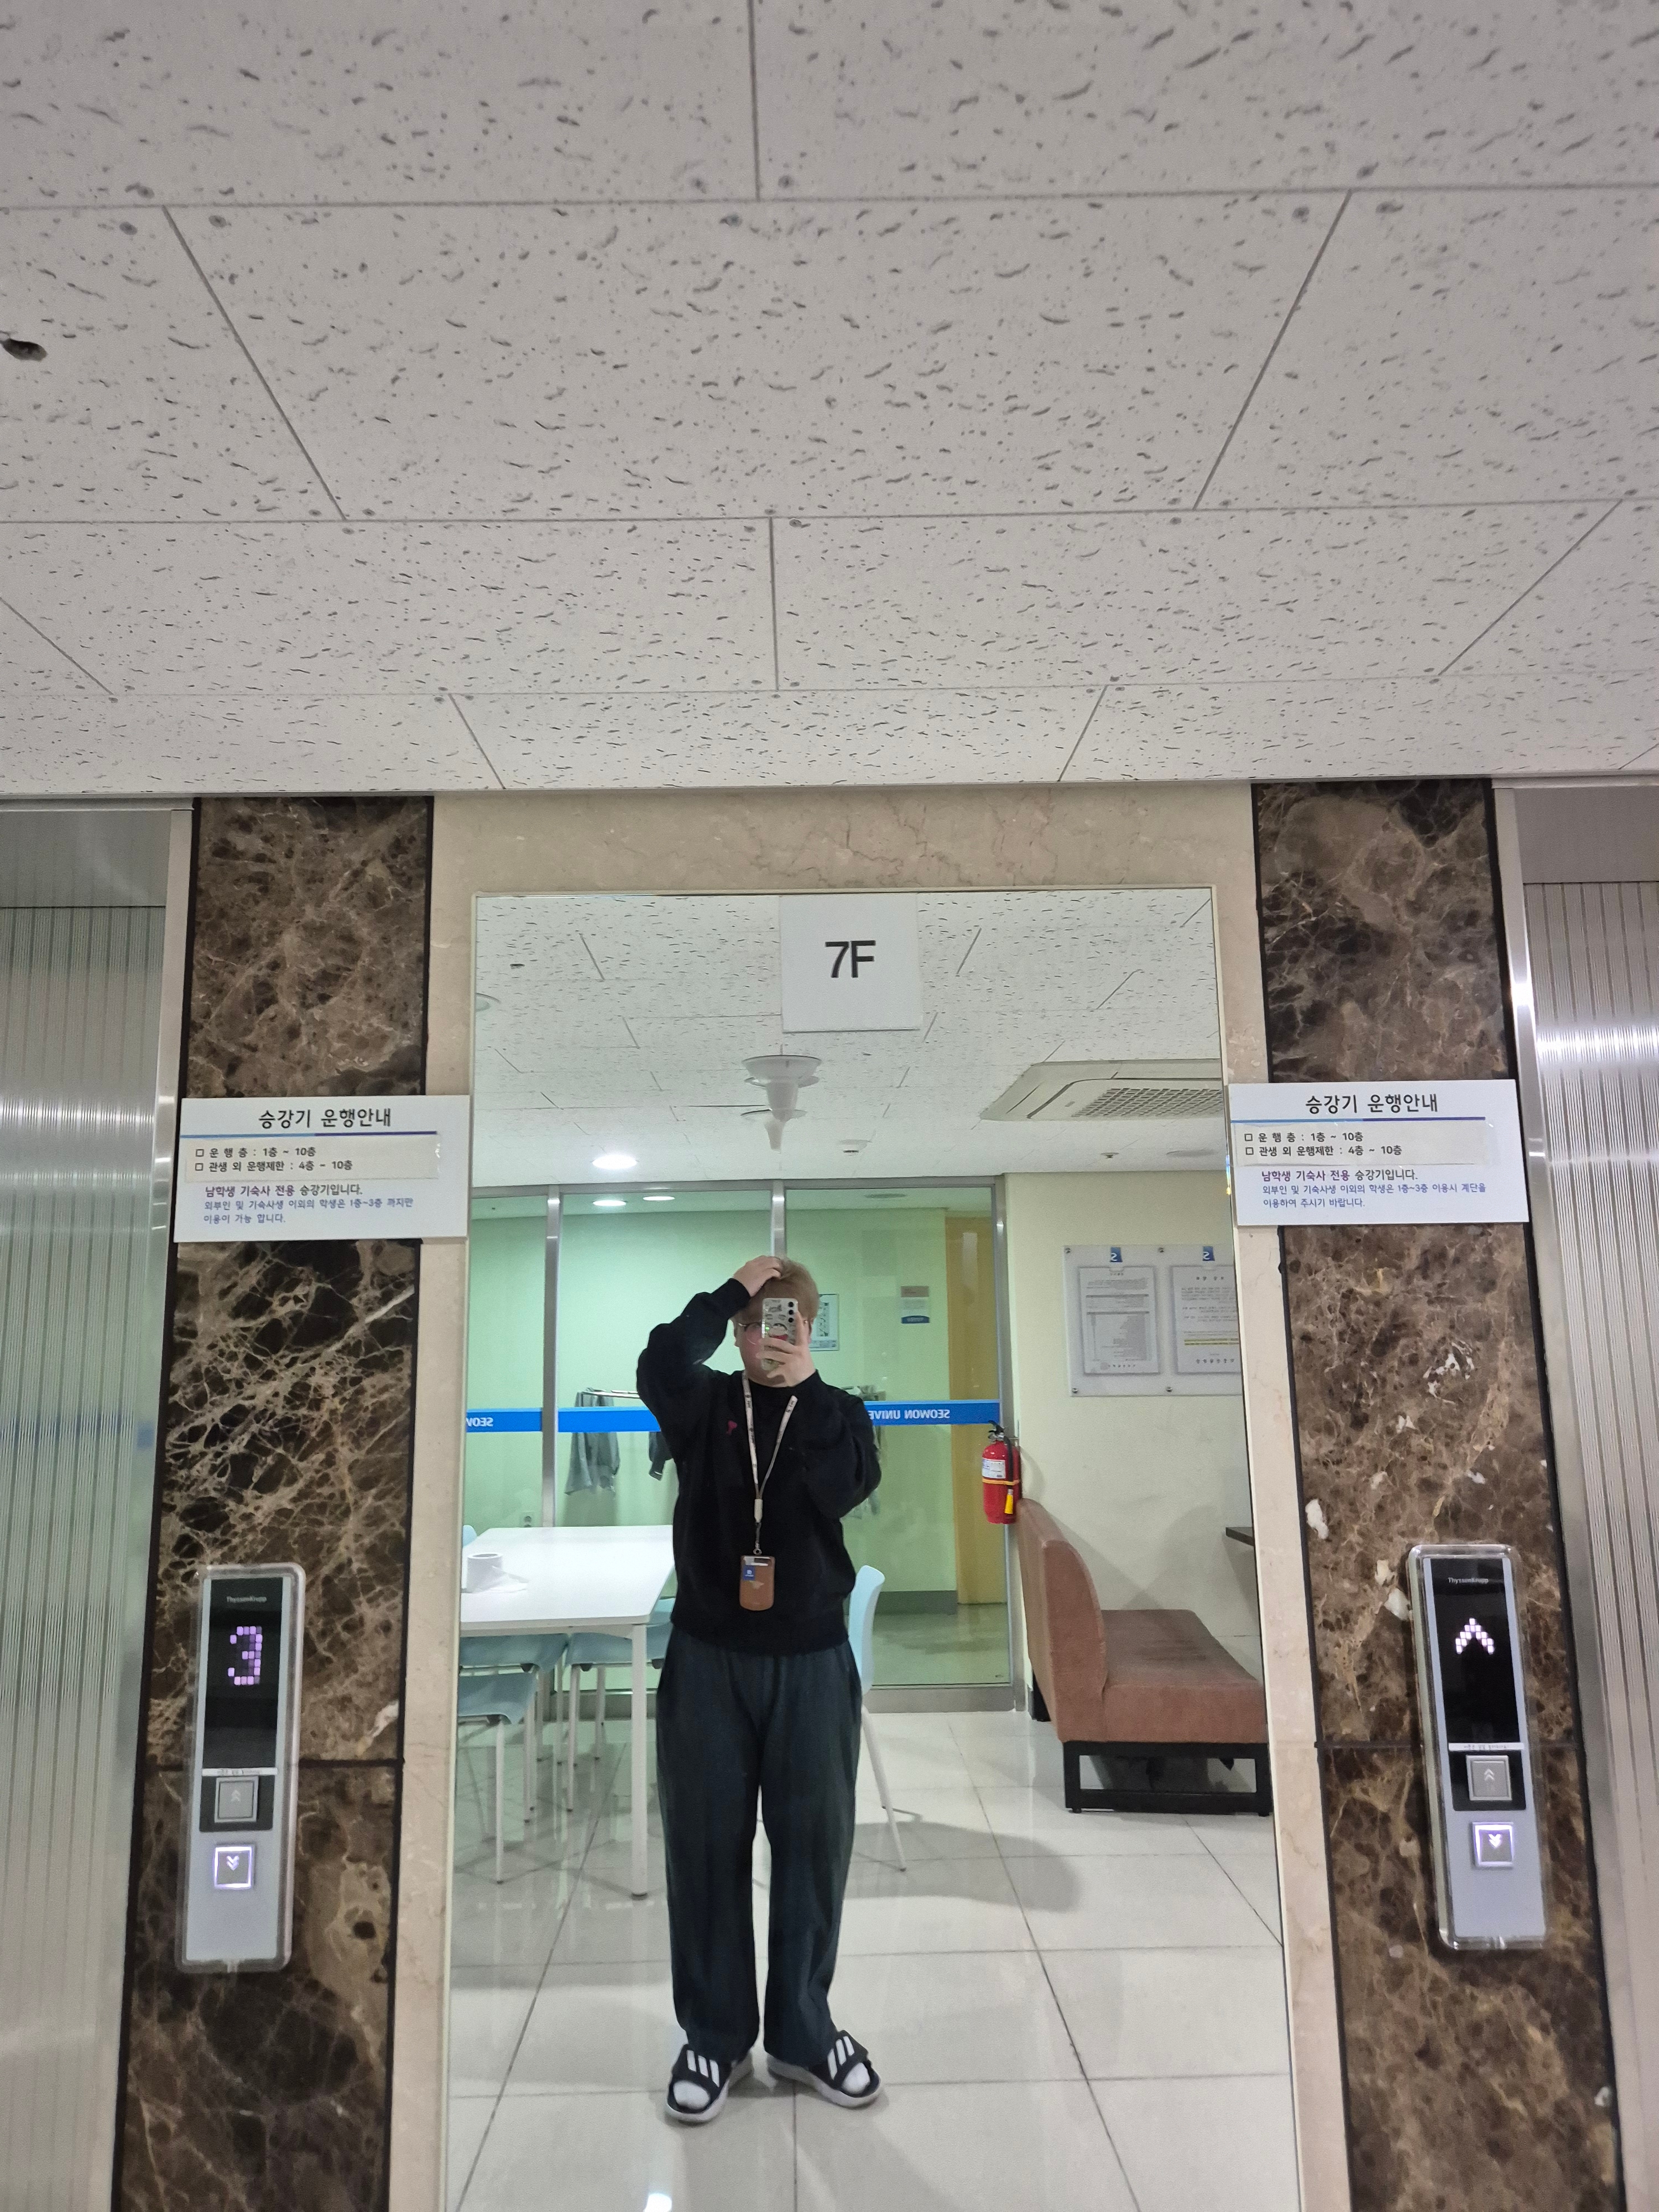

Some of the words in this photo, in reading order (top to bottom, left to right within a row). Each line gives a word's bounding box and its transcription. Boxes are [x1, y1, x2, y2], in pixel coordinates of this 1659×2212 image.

[825, 940, 876, 978] 7F
[1305, 1094, 1358, 1115] 승강기
[1367, 1093, 1438, 1114] 운행안내
[259, 1108, 311, 1129] 승강기
[321, 1108, 392, 1128] 운행안내
[1311, 1132, 1326, 1142] 1층
[1342, 1131, 1364, 1142] 10층
[263, 1147, 278, 1157] 1층
[295, 1146, 316, 1156] 10층
[1259, 1147, 1277, 1156] 관생
[1282, 1146, 1291, 1156] 외
[1297, 1146, 1334, 1156] 운행제한
[1348, 1145, 1364, 1156] 4층
[1381, 1145, 1402, 1156] 10층
[209, 1162, 227, 1172] 관생
[232, 1162, 241, 1172] 외
[247, 1161, 284, 1172] 운행제한
[299, 1161, 315, 1171] 4층
[332, 1160, 353, 1170] 10층
[1262, 1171, 1291, 1182] 남학생
[1296, 1170, 1326, 1181] 기숙사
[1331, 1170, 1350, 1181] 전용
[1355, 1168, 1418, 1181] 승강기입니다.
[206, 1186, 235, 1197] 남학생
[241, 1186, 270, 1197] 기숙사
[275, 1185, 295, 1196] 전용
[300, 1184, 363, 1196] 승강기입니다.
[1262, 1186, 1287, 1194] 외부인
[1291, 1186, 1299, 1194] 및
[1303, 1185, 1336, 1194] 기숙사생
[1340, 1185, 1365, 1193] 이외의
[1369, 1184, 1394, 1193] 학생은
[1432, 1183, 1457, 1193] 이용시
[1462, 1183, 1486, 1192] 계단을
[205, 1201, 231, 1211] 외부인
[236, 1201, 243, 1210] 및
[249, 1200, 284, 1210] 기숙사생
[289, 1199, 315, 1209] 이외의
[320, 1199, 346, 1209] 학생은
[1264, 1199, 1296, 1208] 이용하여
[1301, 1198, 1325, 1207] 주시기
[1329, 1198, 1365, 1208] 바랍니다.
[204, 1215, 230, 1224] 이용이
[234, 1214, 252, 1224] 가능
[257, 1214, 286, 1223] 합니다.
[227, 1626, 263, 1685] 3
